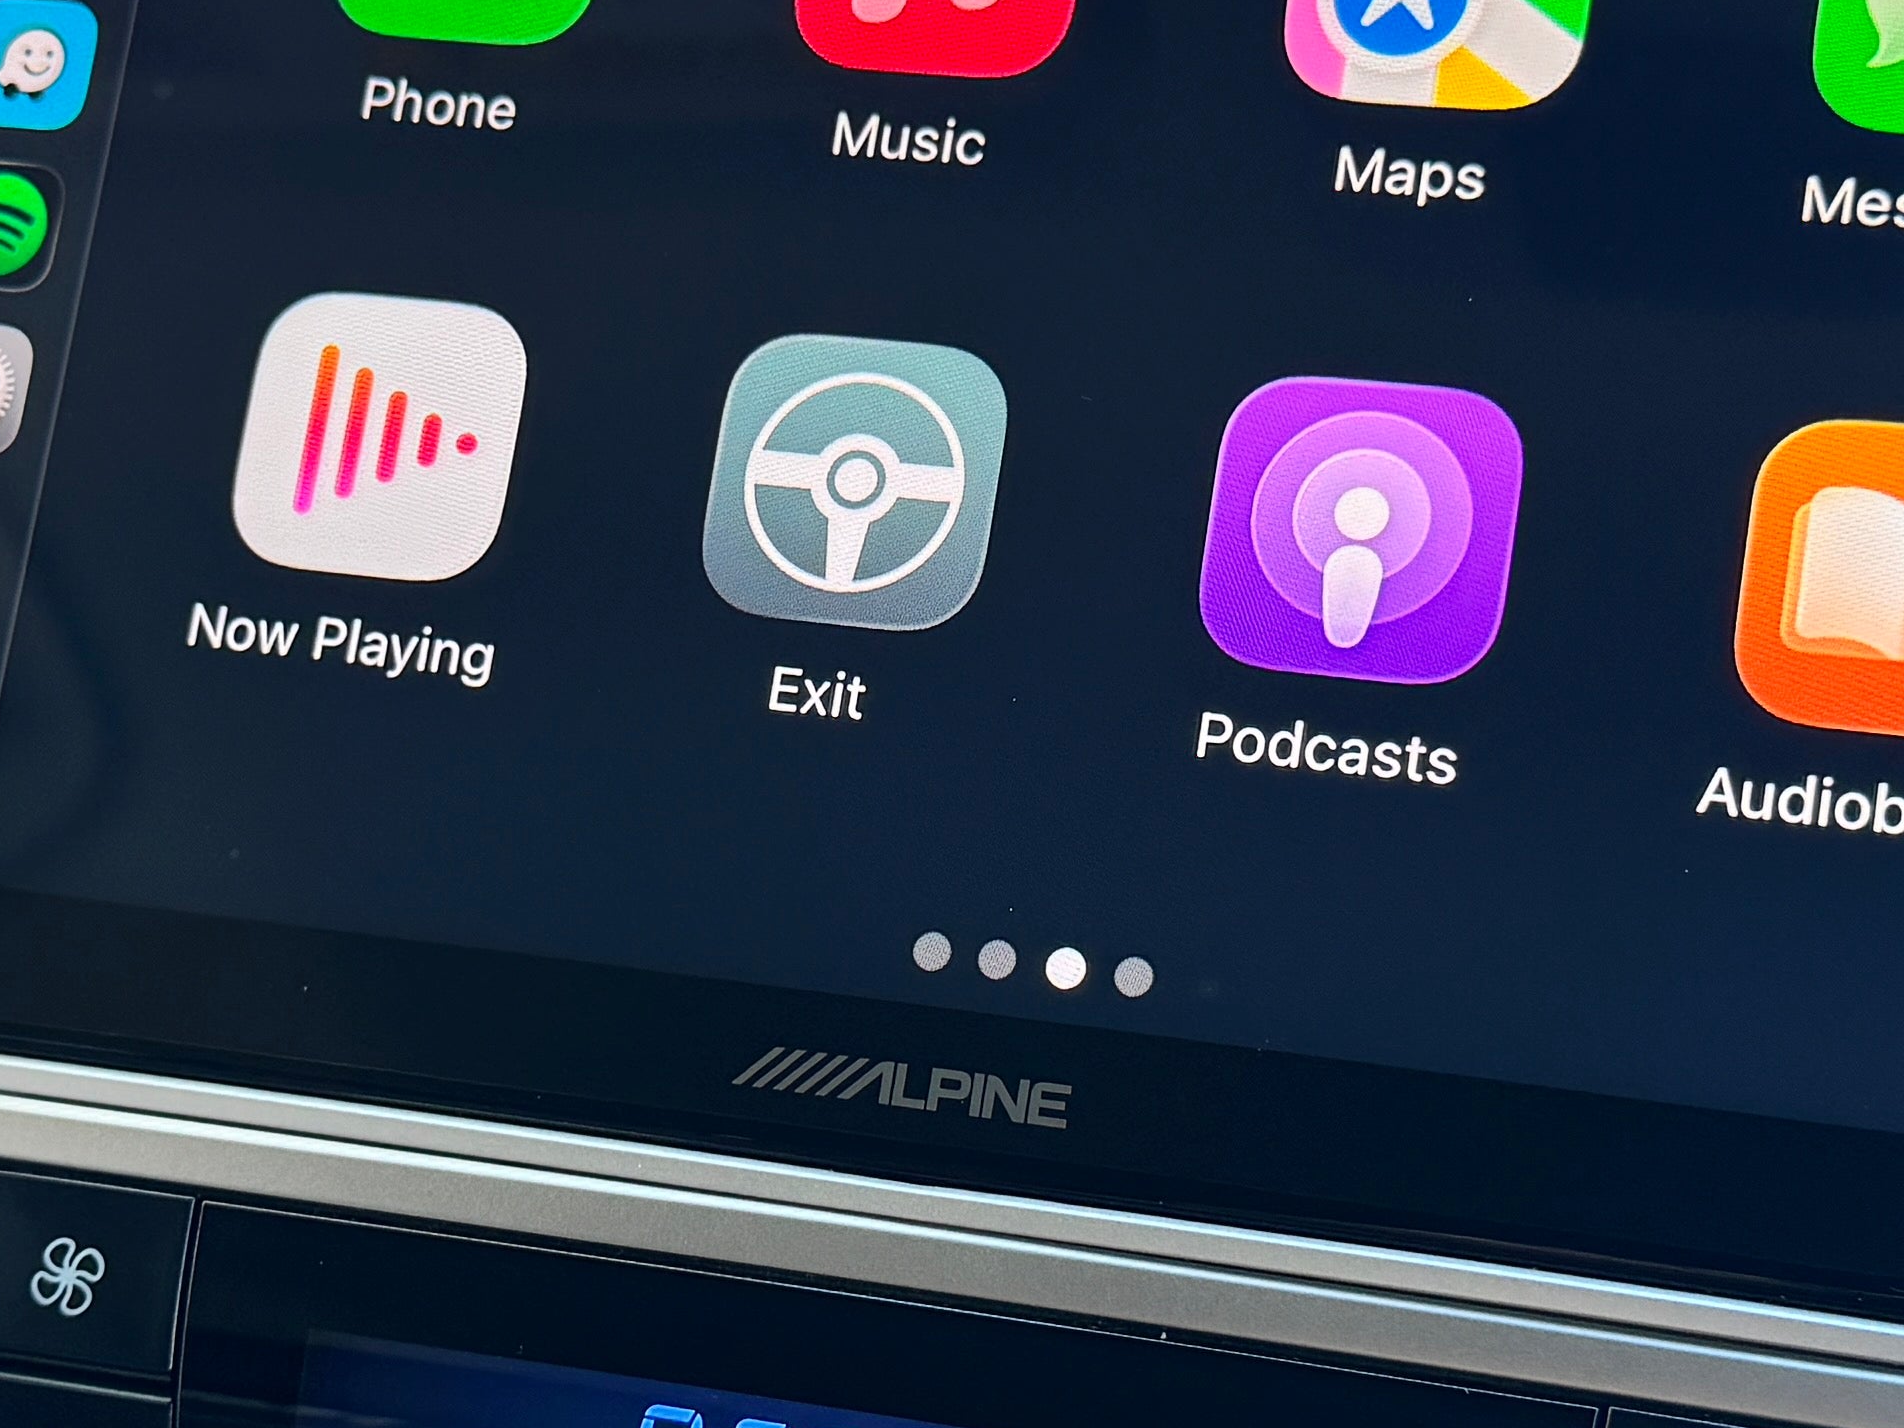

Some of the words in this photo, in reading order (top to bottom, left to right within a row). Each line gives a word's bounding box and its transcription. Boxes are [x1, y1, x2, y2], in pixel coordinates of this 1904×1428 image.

[361, 75, 516, 130] Phone
[832, 111, 986, 166] Music
[1334, 145, 1485, 207] Maps
[187, 602, 300, 657] Now
[311, 615, 495, 688] Playing
[768, 665, 867, 721] Exit
[1196, 711, 1458, 785] Podcasts
[837, 1056, 1073, 1129] ALPINE
